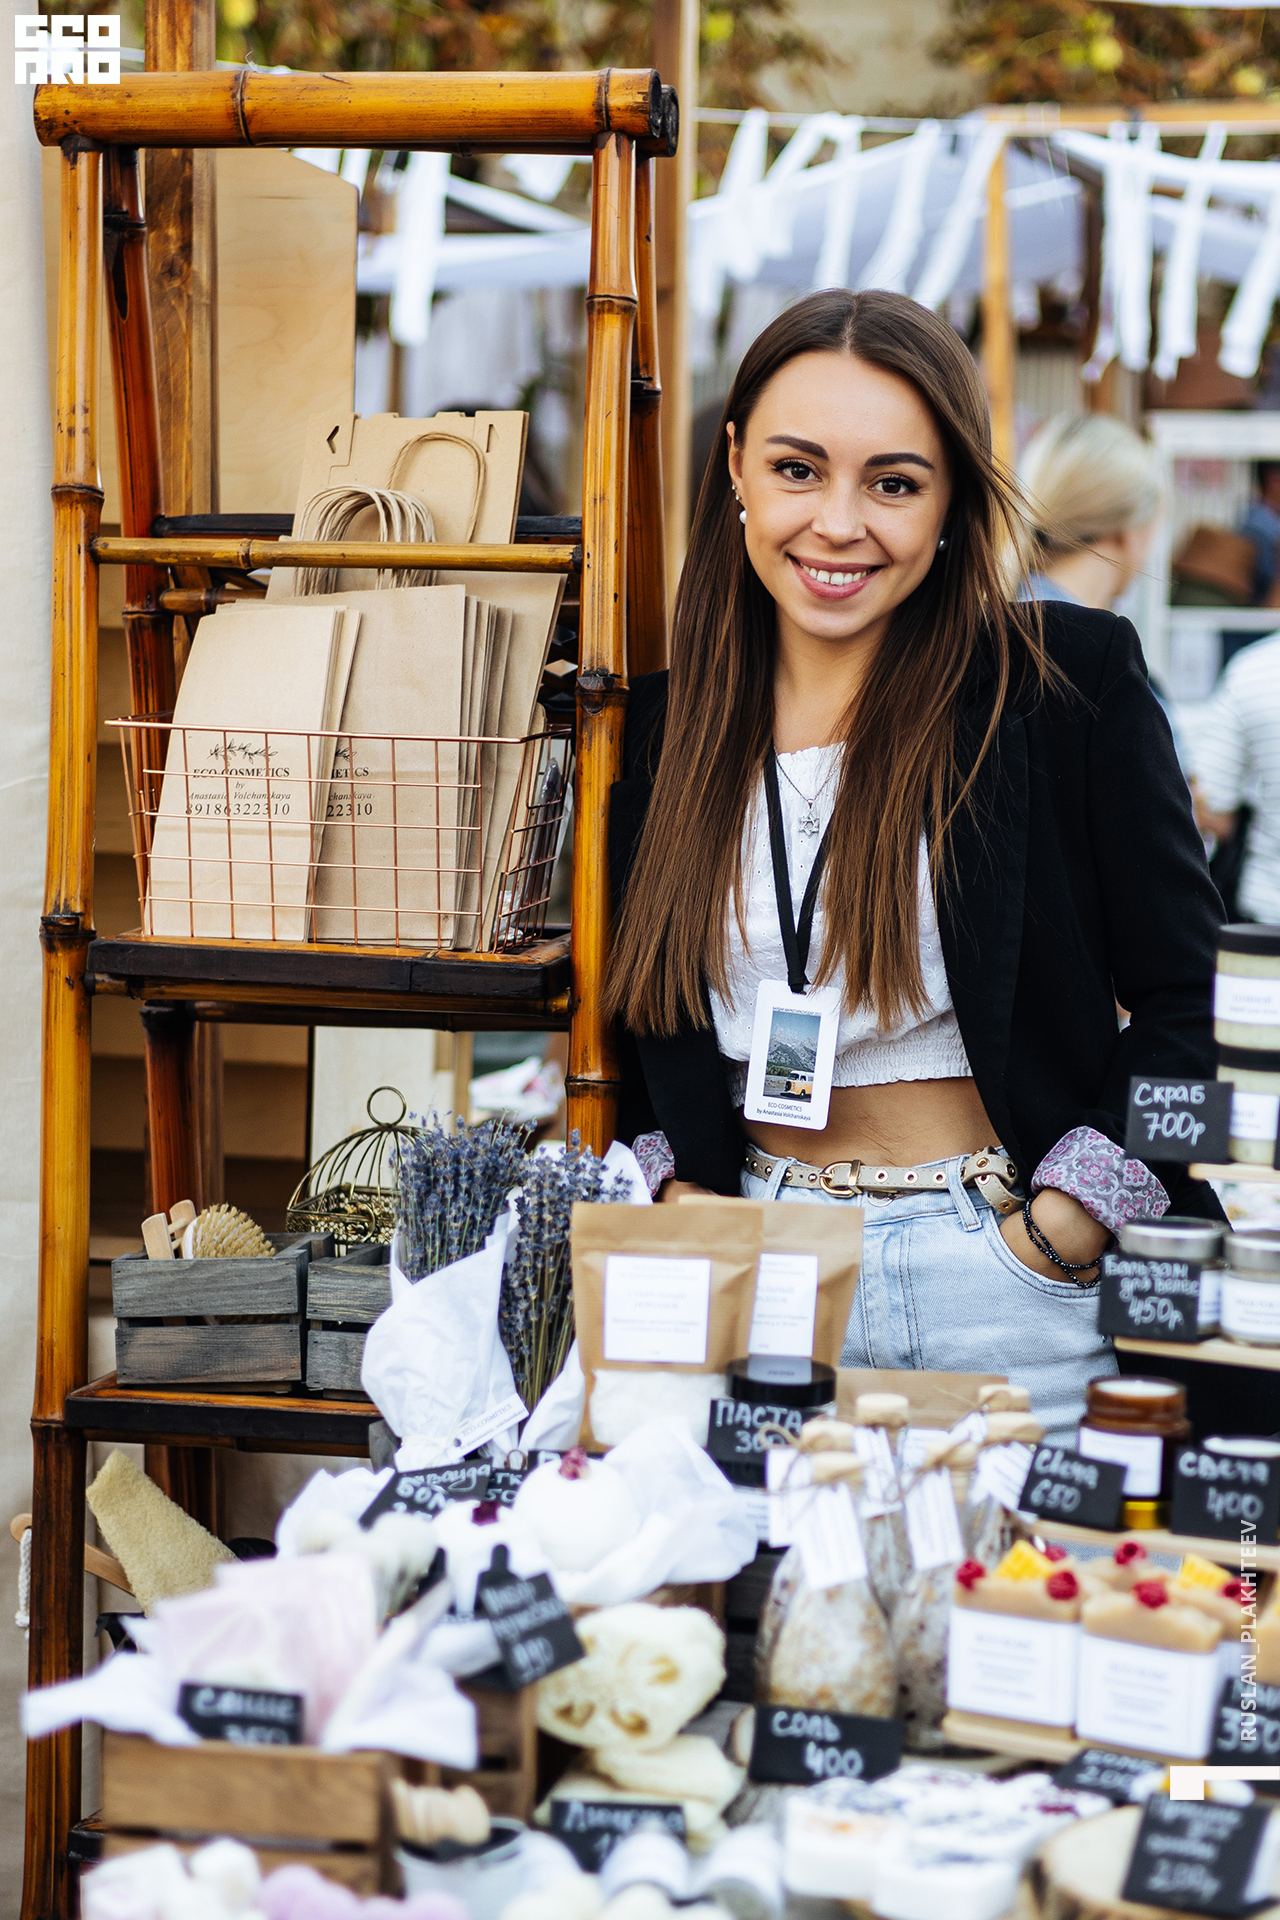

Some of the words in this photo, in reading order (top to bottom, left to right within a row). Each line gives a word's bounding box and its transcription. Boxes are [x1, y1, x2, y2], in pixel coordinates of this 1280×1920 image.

[235, 781, 245, 790] by
[233, 792, 291, 801] Volchankaya
[768, 1101, 803, 1112] ECO-COSMETICS
[1206, 1486, 1265, 1522] 400
[804, 1740, 864, 1778] 400
